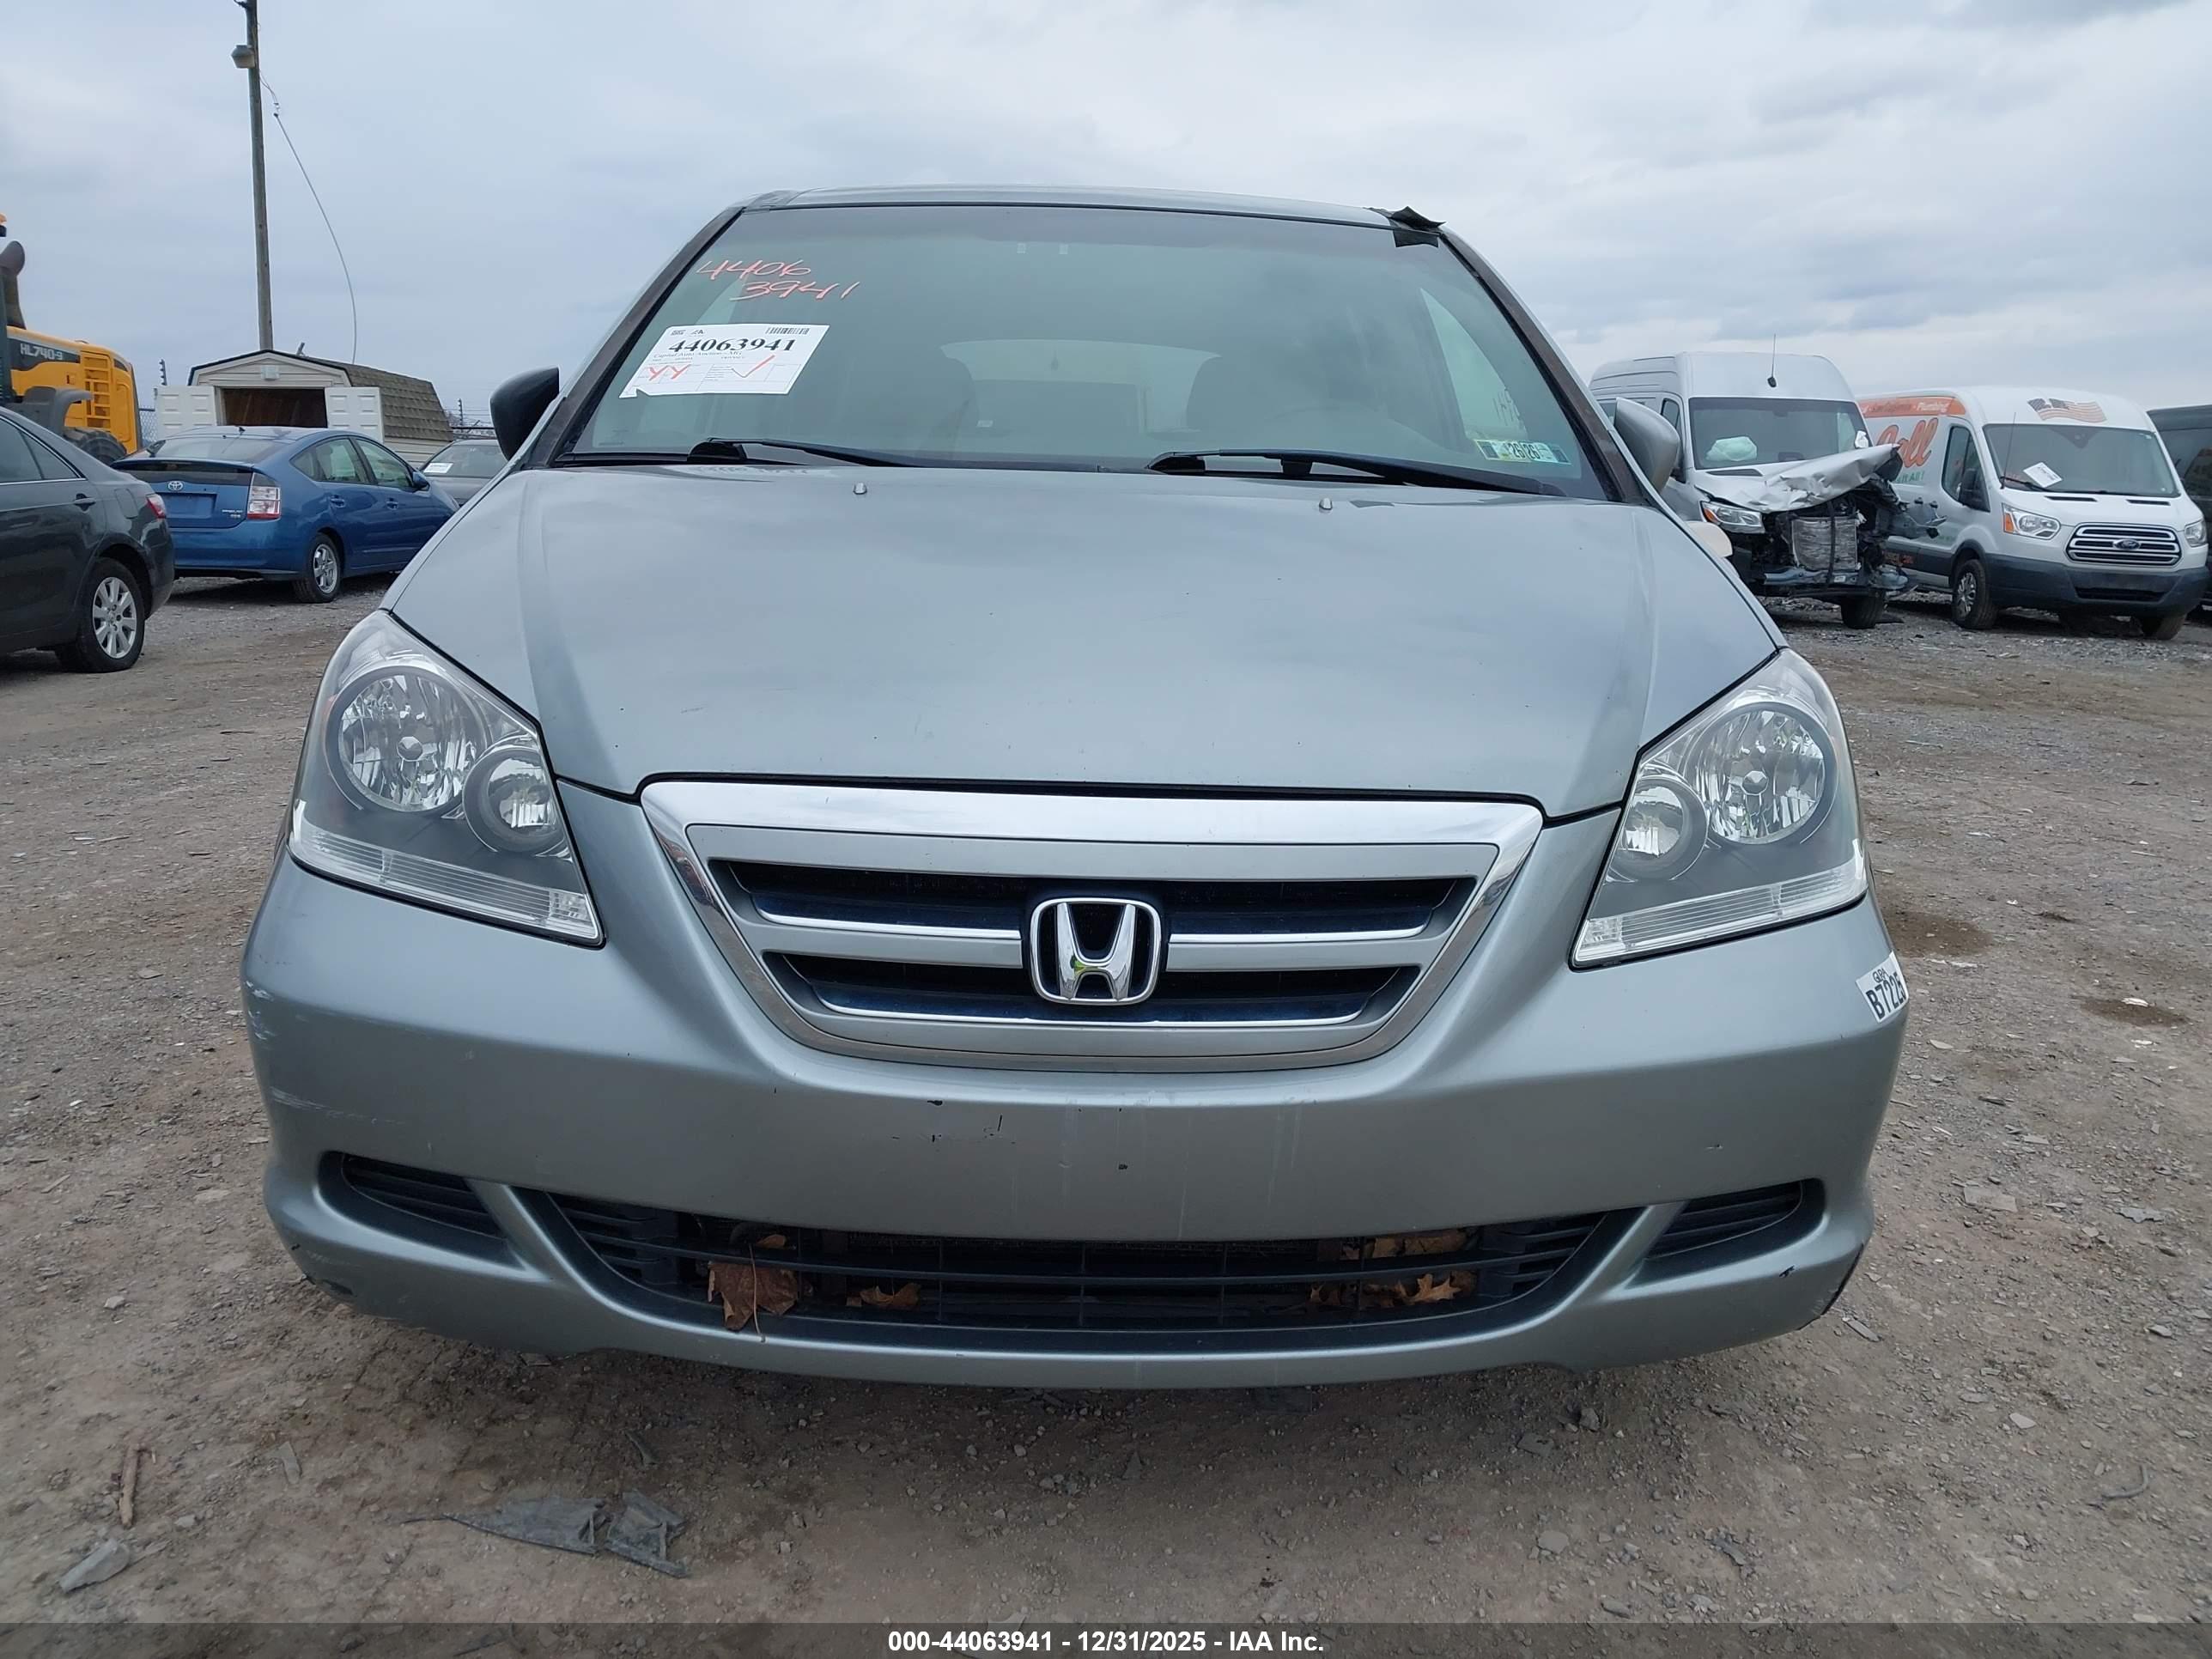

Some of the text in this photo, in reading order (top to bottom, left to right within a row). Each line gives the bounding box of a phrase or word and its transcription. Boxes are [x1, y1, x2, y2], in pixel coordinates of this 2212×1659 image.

[696, 260, 811, 280] 4406
[730, 281, 860, 301] 3941
[21, 343, 63, 360] HL740-9
[669, 338, 796, 352] 44063941
